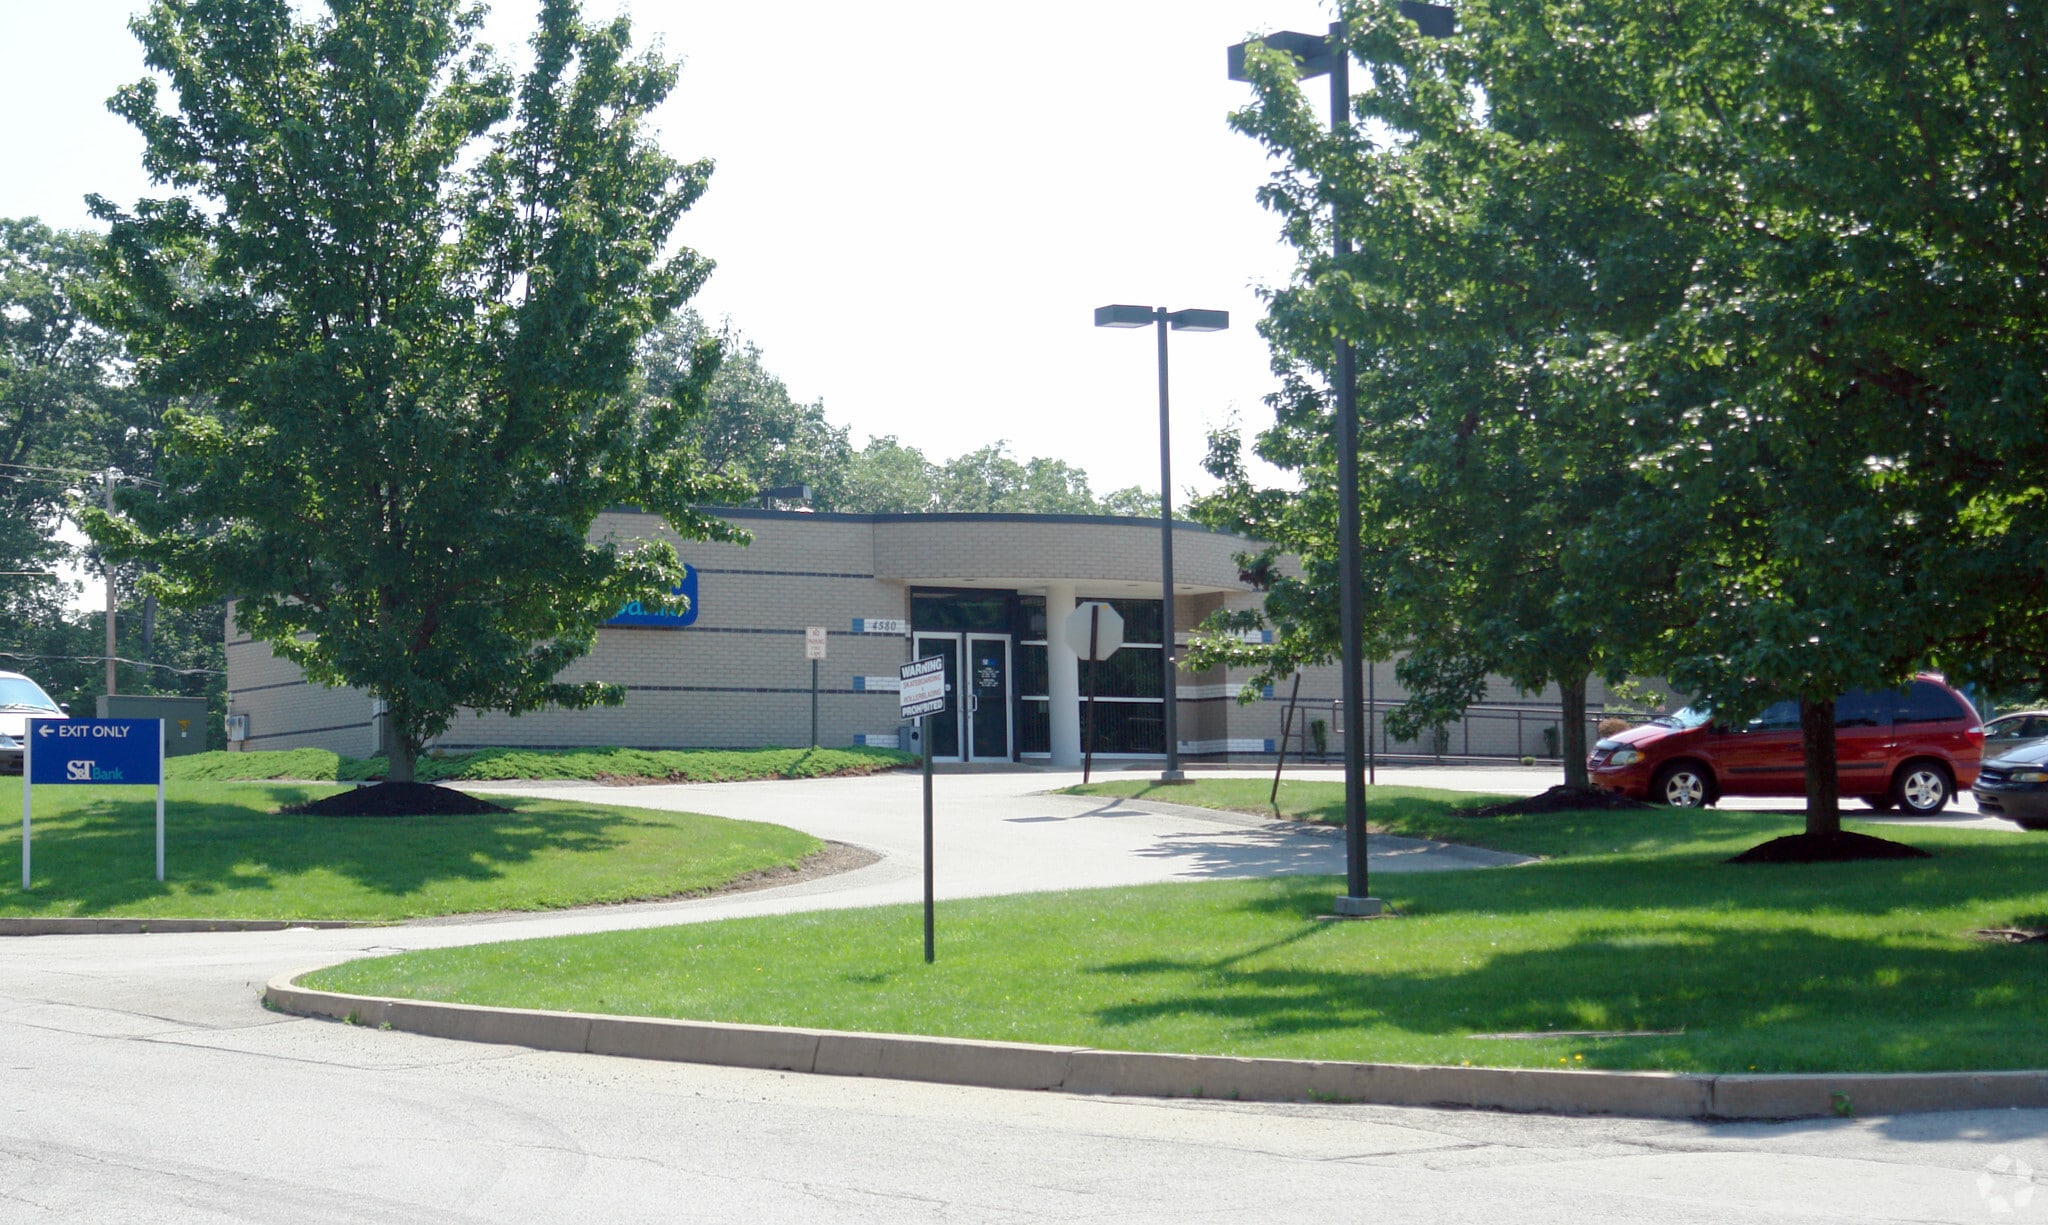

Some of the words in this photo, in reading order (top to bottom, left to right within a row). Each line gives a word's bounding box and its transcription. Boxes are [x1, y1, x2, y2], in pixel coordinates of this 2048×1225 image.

[872, 621, 897, 631] 4580
[901, 658, 942, 679] WARNING
[902, 699, 943, 718] PROHIBITED
[59, 725, 89, 737] EXIT
[92, 725, 130, 738] ONLY
[66, 759, 95, 780] S&T
[92, 767, 123, 780] Bank
